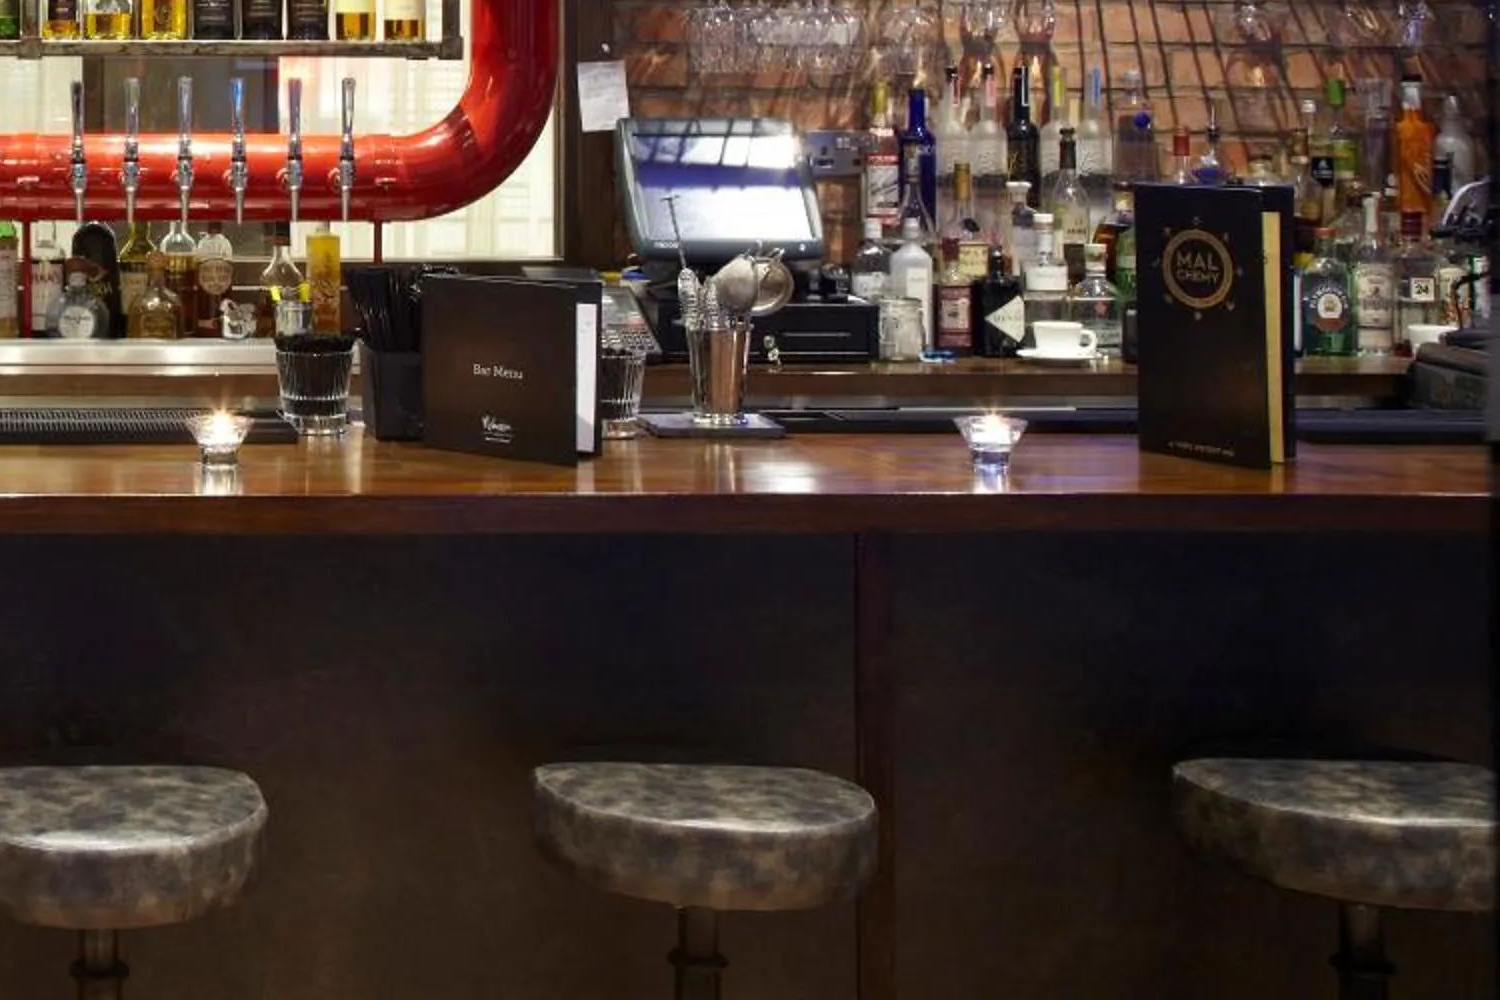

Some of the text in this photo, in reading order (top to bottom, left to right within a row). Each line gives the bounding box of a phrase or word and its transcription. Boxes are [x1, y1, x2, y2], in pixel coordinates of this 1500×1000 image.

[1177, 250, 1219, 270] MAL
[1415, 283, 1429, 295] 24
[473, 363, 523, 379] Bar Menu
